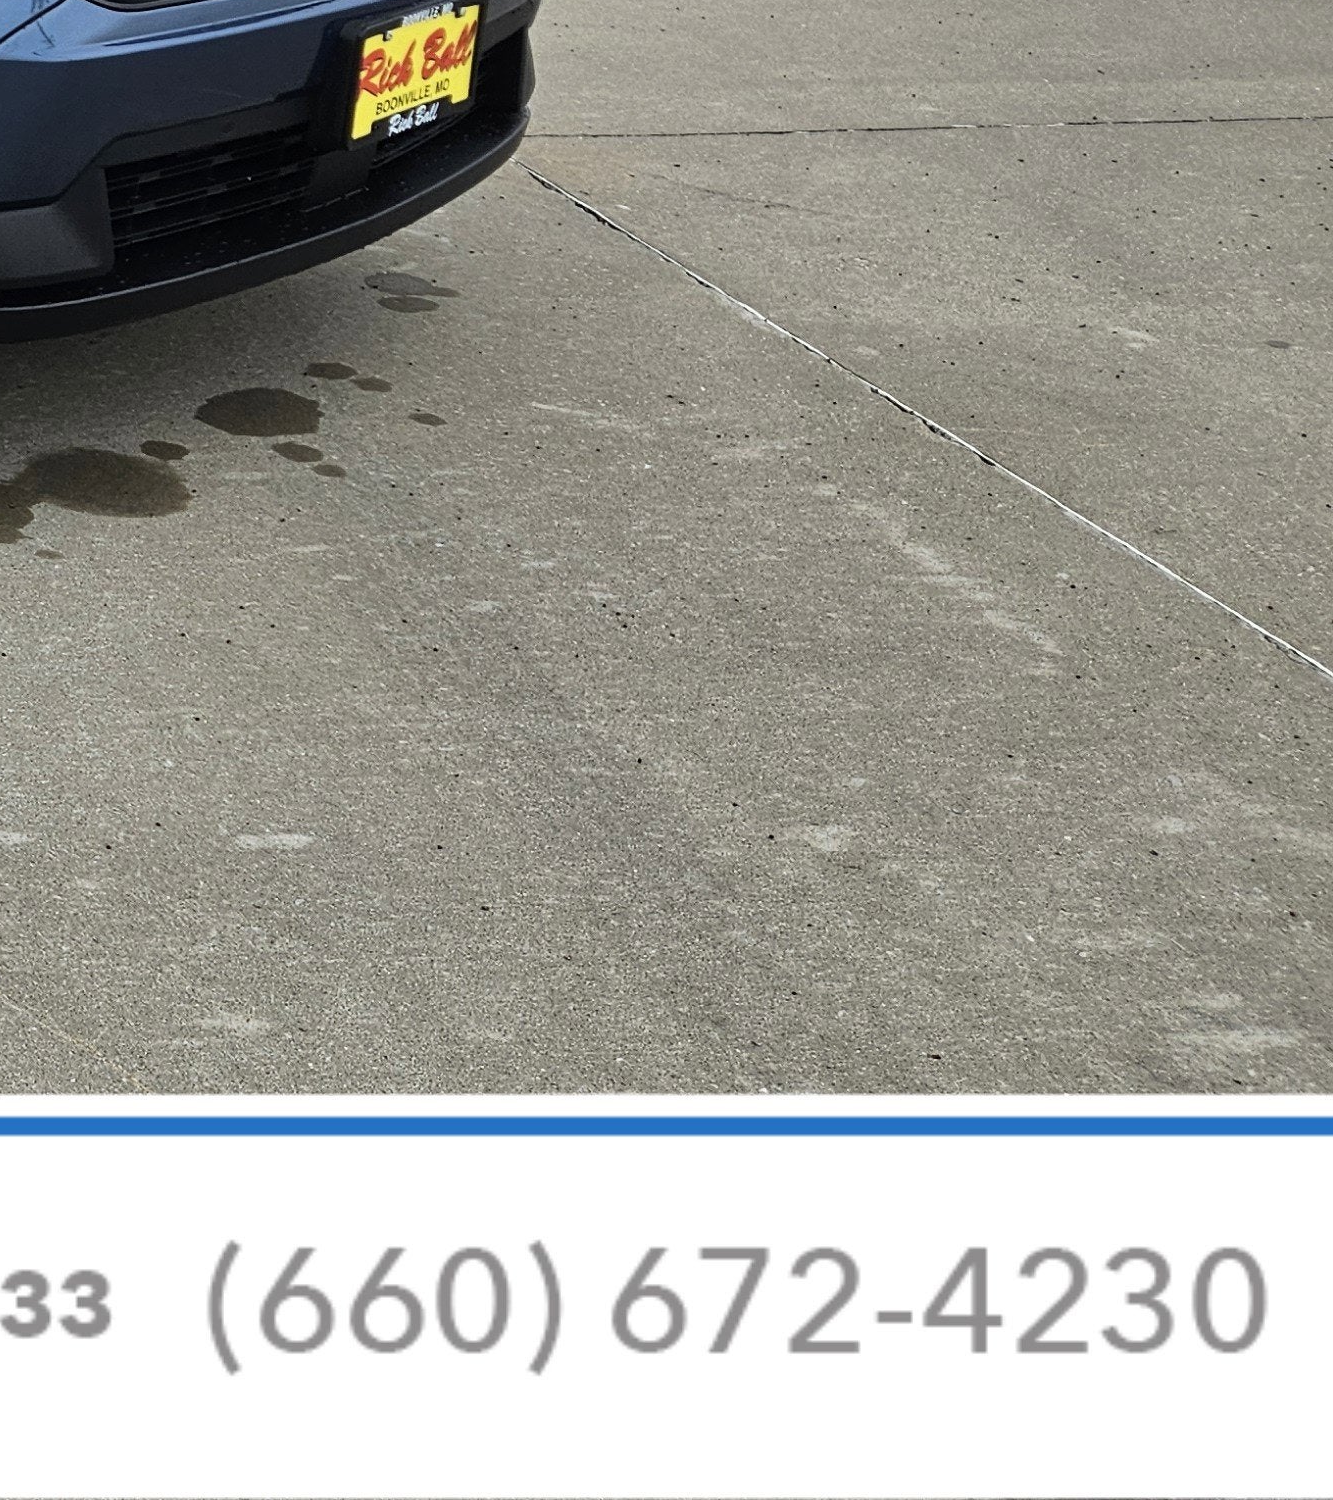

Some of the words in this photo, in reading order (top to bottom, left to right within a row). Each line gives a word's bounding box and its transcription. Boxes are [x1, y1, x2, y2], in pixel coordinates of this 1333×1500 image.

[358, 39, 417, 97] Rick
[421, 20, 478, 80] Ball
[376, 85, 433, 115] BOONVILLE,
[435, 78, 450, 95] MO
[388, 111, 414, 137] Rick
[414, 102, 440, 128] Ball
